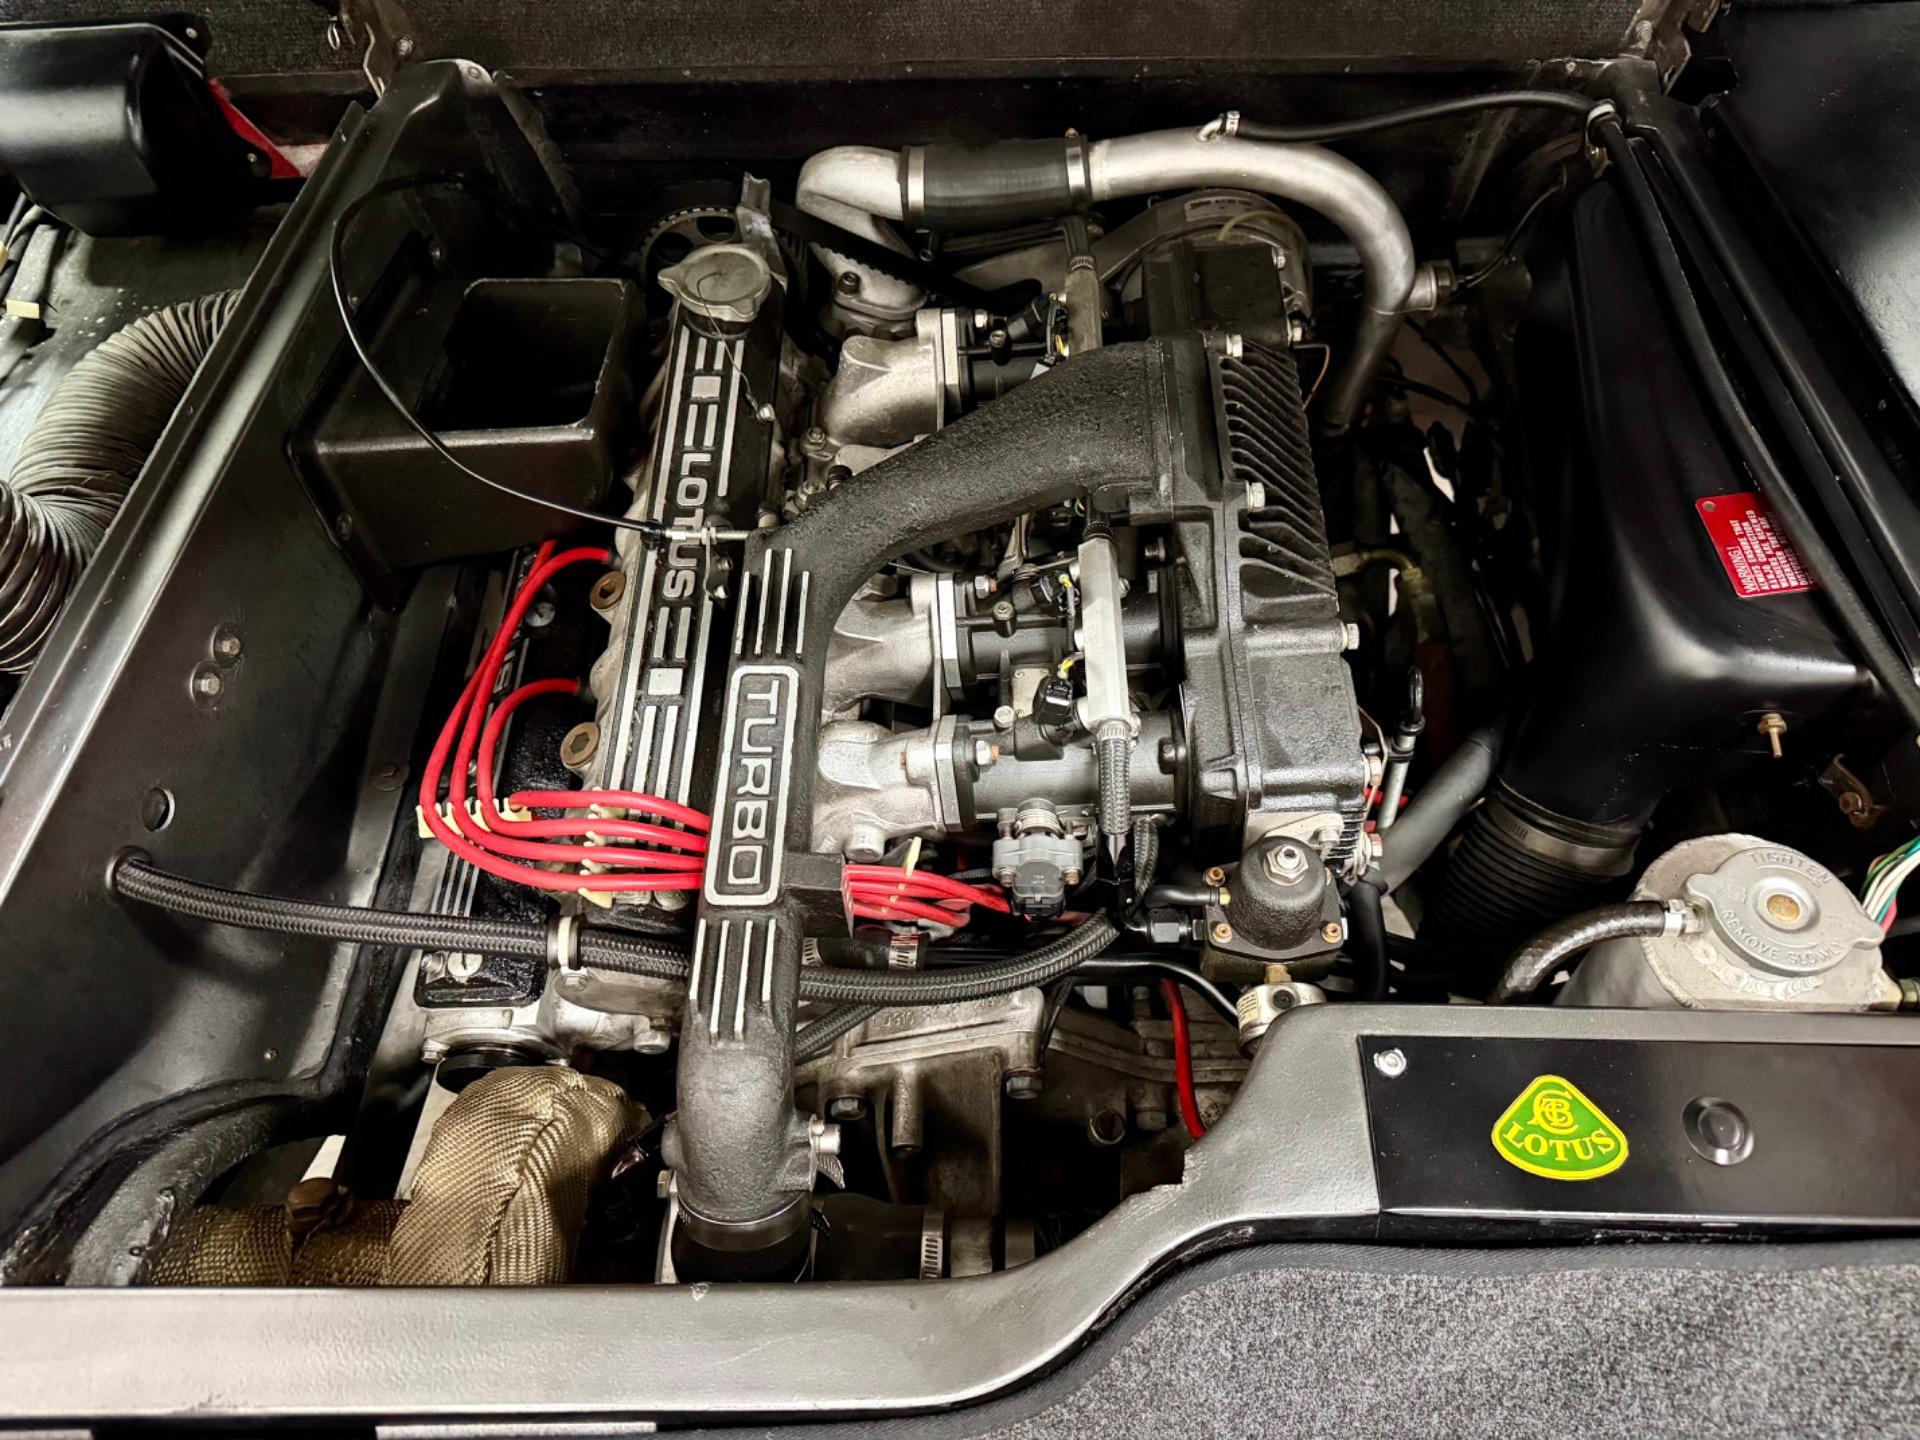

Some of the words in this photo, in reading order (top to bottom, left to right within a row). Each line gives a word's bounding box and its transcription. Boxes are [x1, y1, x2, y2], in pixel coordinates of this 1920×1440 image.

[663, 453, 711, 598] LOTUS
[1729, 520, 1743, 535] THAT
[1726, 545, 1757, 593] WARNING!
[1738, 537, 1757, 563] ENSURE
[1752, 565, 1771, 590] ALWAYS
[727, 680, 780, 884] TURBO
[1748, 850, 1833, 884] TIGHTEN
[1722, 909, 1781, 959] REMOVE
[1503, 1120, 1616, 1161] LOTUS
